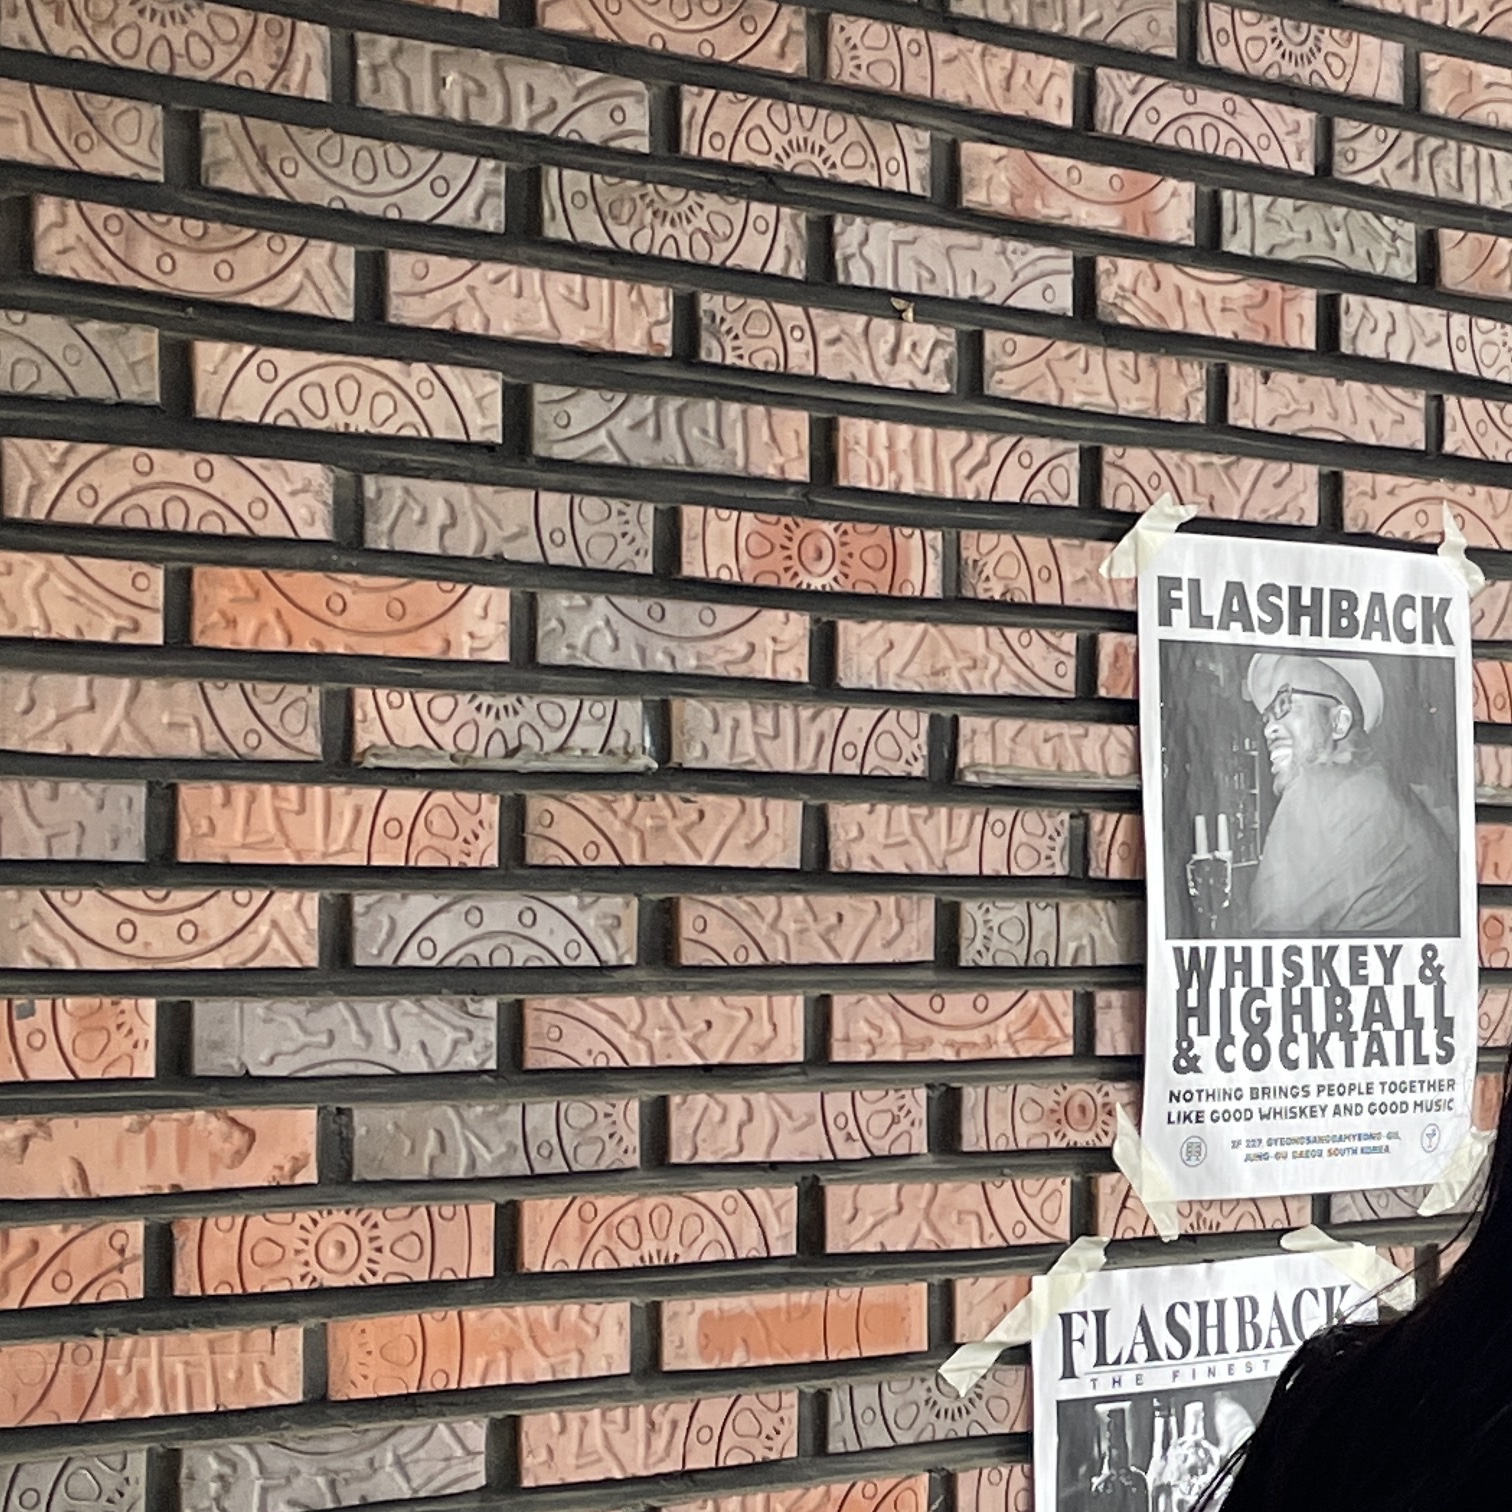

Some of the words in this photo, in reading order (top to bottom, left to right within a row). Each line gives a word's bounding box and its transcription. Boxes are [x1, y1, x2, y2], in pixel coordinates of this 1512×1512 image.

[1157, 575, 1455, 646] FLASHBACK
[1172, 944, 1403, 988] WHISKEY
[1418, 943, 1446, 986] &
[1176, 985, 1454, 1036] HIGHBALL
[1172, 1034, 1203, 1075] &
[1215, 1029, 1455, 1073] COCKTAILS
[1167, 1110, 1206, 1125] LIKE
[1210, 1108, 1254, 1123] GOOD
[1258, 1104, 1328, 1120] WHISKEY
[1332, 1103, 1364, 1117] AND
[1368, 1101, 1409, 1115] GOOD
[1413, 1098, 1455, 1114] MUSIC
[1168, 1087, 1244, 1103] NOTHING
[1250, 1083, 1311, 1101] BRINGS
[1316, 1081, 1375, 1098] PEOPLE
[1379, 1078, 1456, 1094] TOGETHER
[1090, 1373, 1145, 1391] THE
[1171, 1358, 1272, 1384] FINEST
